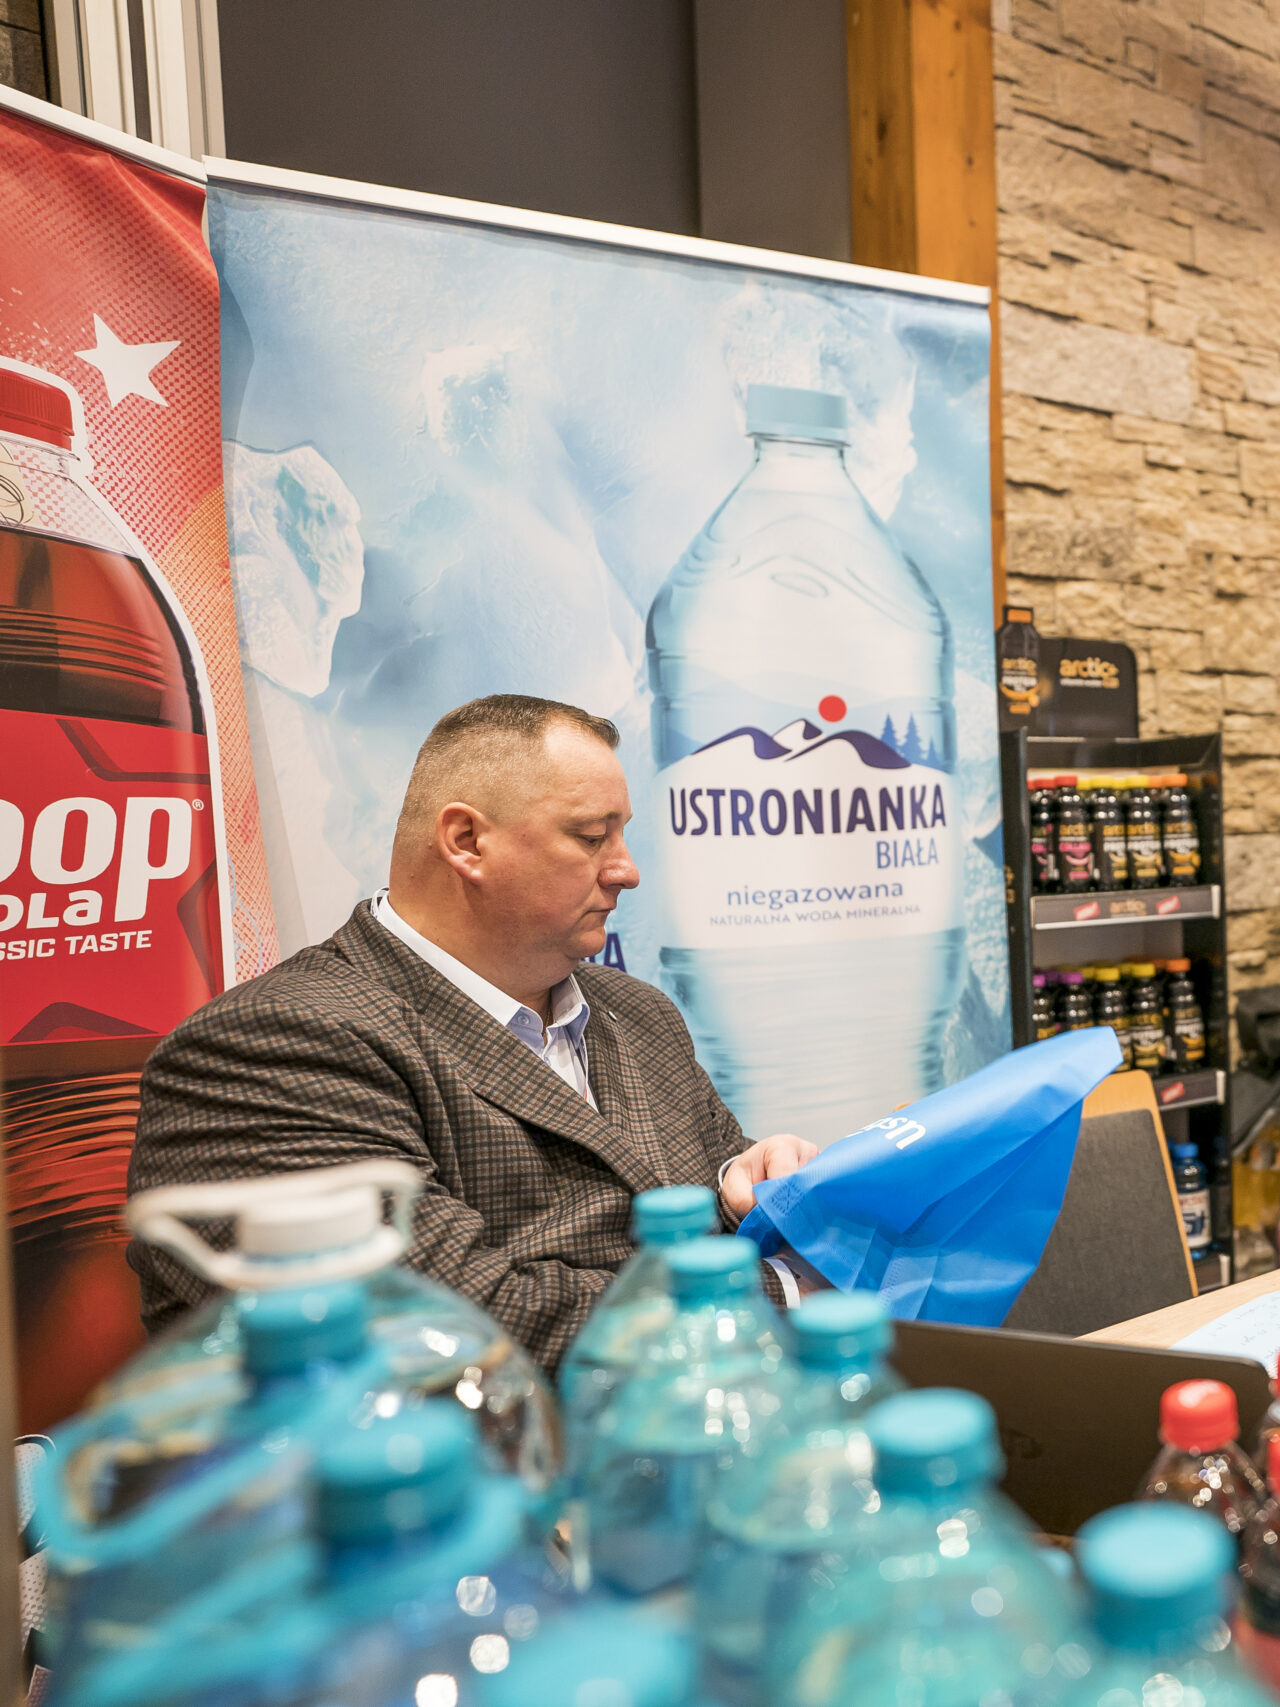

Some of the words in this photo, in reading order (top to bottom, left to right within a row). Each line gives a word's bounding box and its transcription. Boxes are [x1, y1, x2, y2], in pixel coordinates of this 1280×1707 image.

[670, 784, 946, 836] USTRONIANKA
[876, 837, 939, 869] BIAŁA
[727, 882, 904, 910] niegazowana
[709, 913, 791, 926] NATURALNA
[795, 910, 842, 922] WODA
[846, 904, 921, 920] MINERALNA
[64, 930, 152, 955] TASTE
